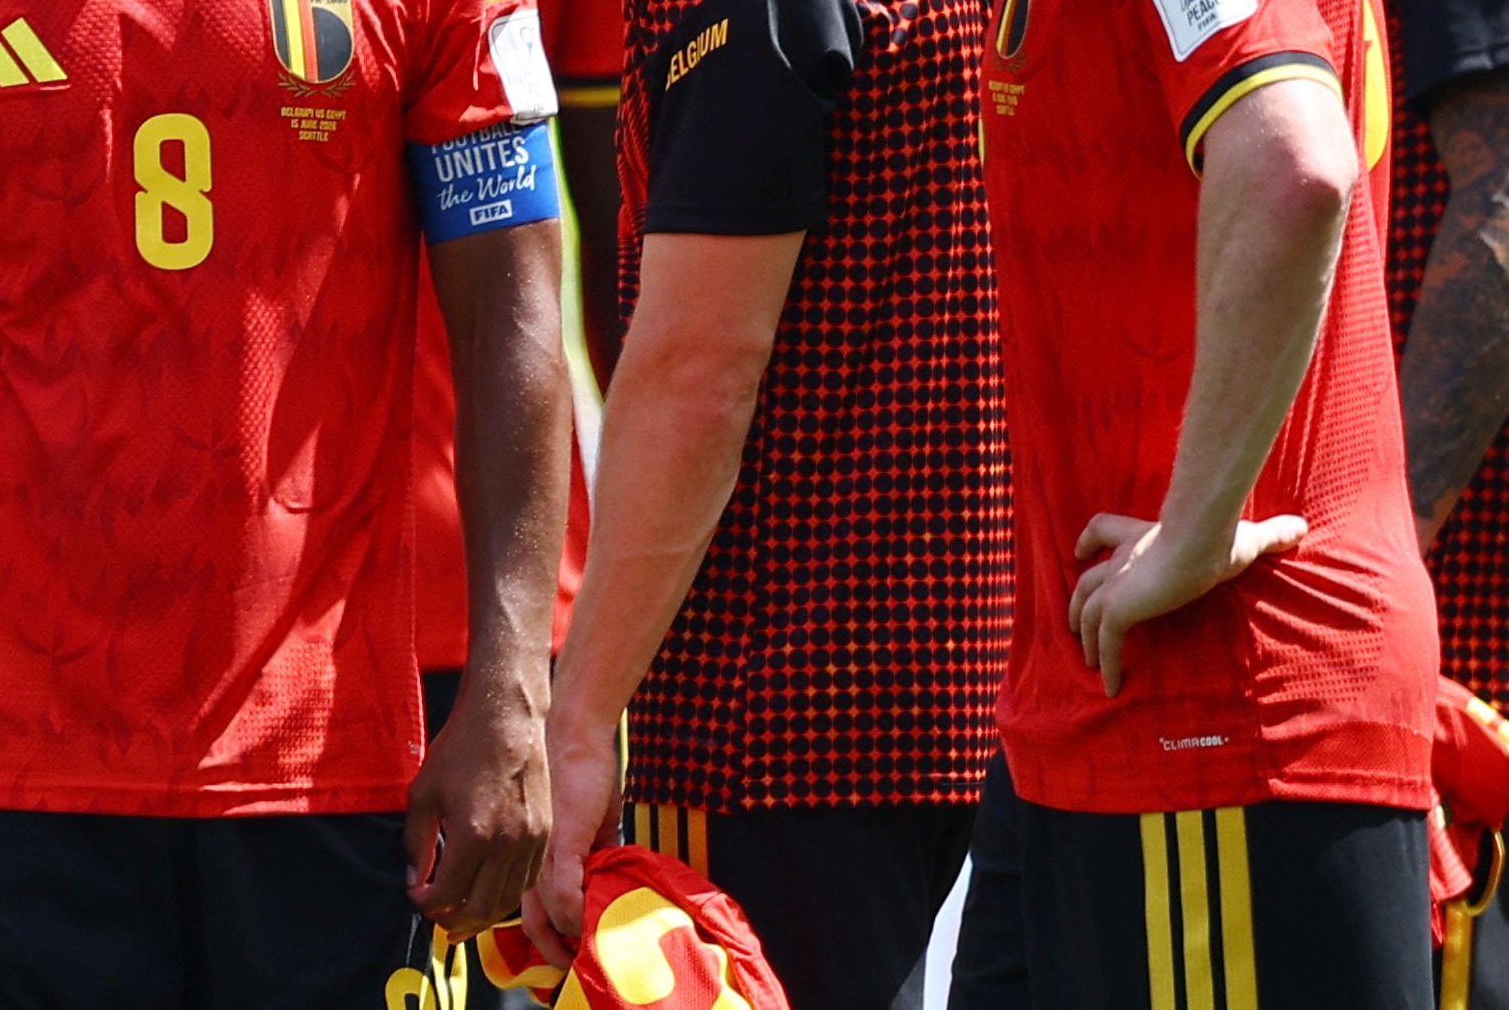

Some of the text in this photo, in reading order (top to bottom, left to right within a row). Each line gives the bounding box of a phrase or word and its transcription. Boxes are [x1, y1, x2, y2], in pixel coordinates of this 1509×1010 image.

[299, 130, 329, 142] SEATTLE
[435, 136, 529, 183] UNITES
[133, 112, 214, 271] 8
[437, 164, 537, 211] the World
[473, 203, 510, 222] FIFA
